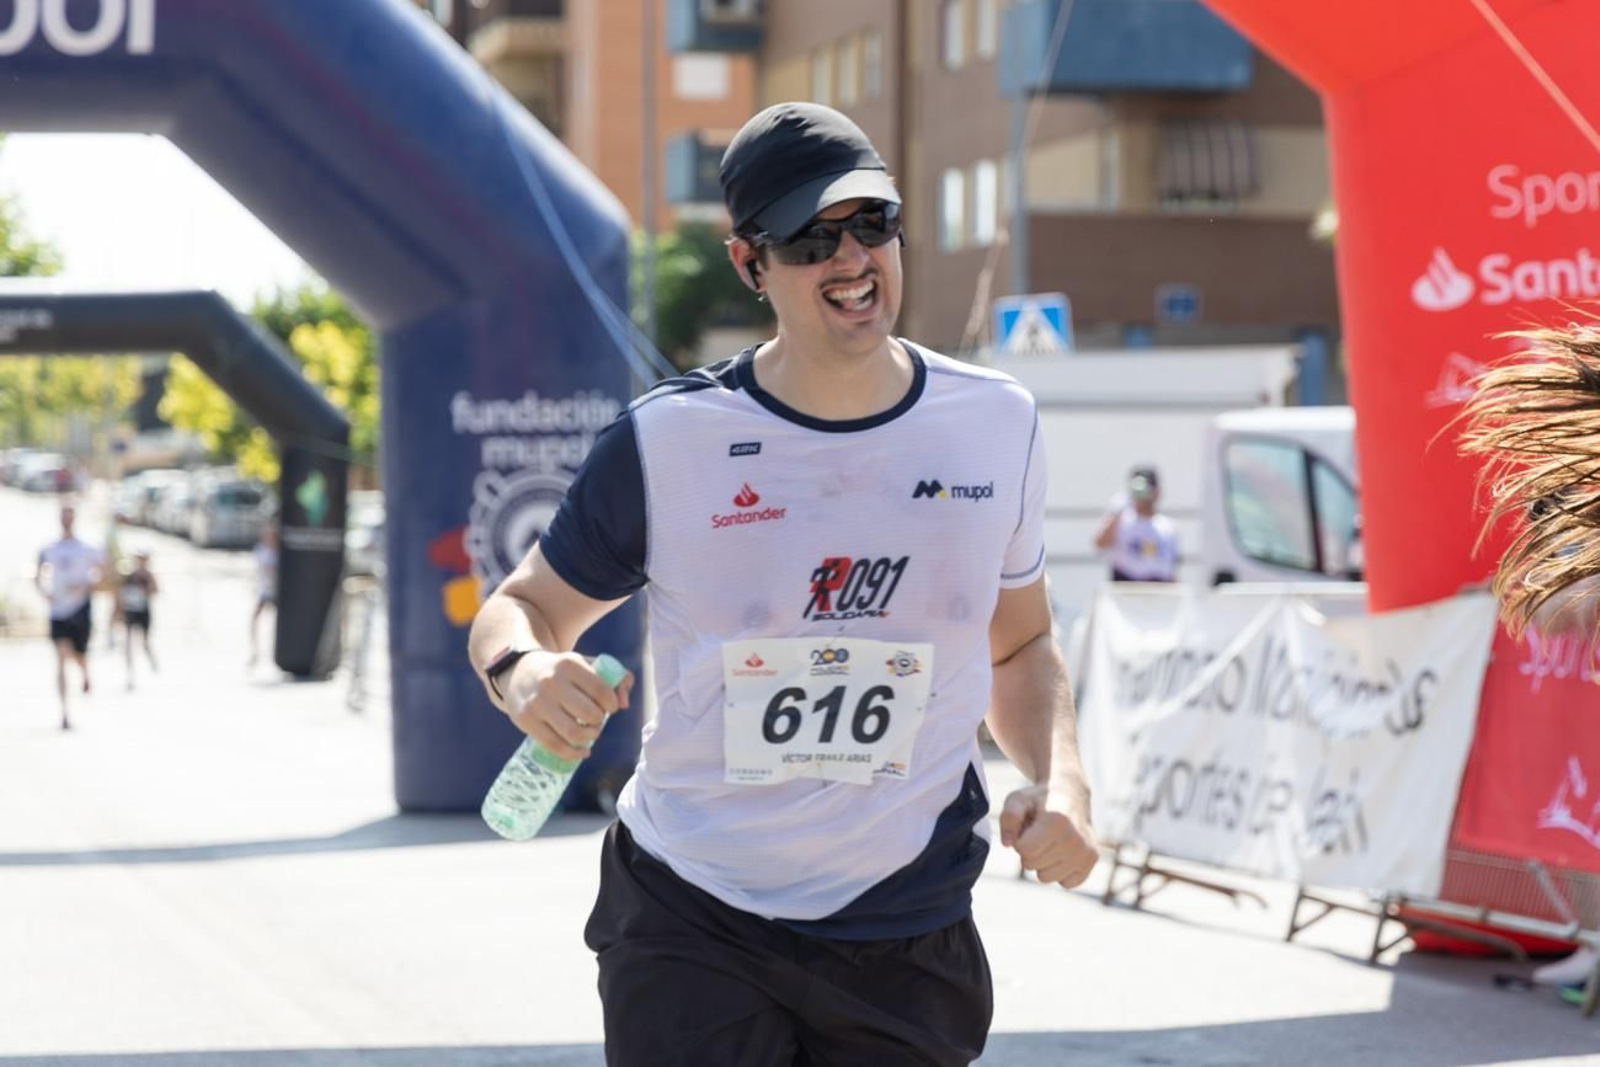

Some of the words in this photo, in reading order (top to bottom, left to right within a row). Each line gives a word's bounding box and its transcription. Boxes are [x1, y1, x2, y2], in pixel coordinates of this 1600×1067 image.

[1478, 247, 1600, 305] Sant
[951, 481, 994, 502] mupol
[711, 506, 786, 528] Santander
[762, 685, 895, 744] 616
